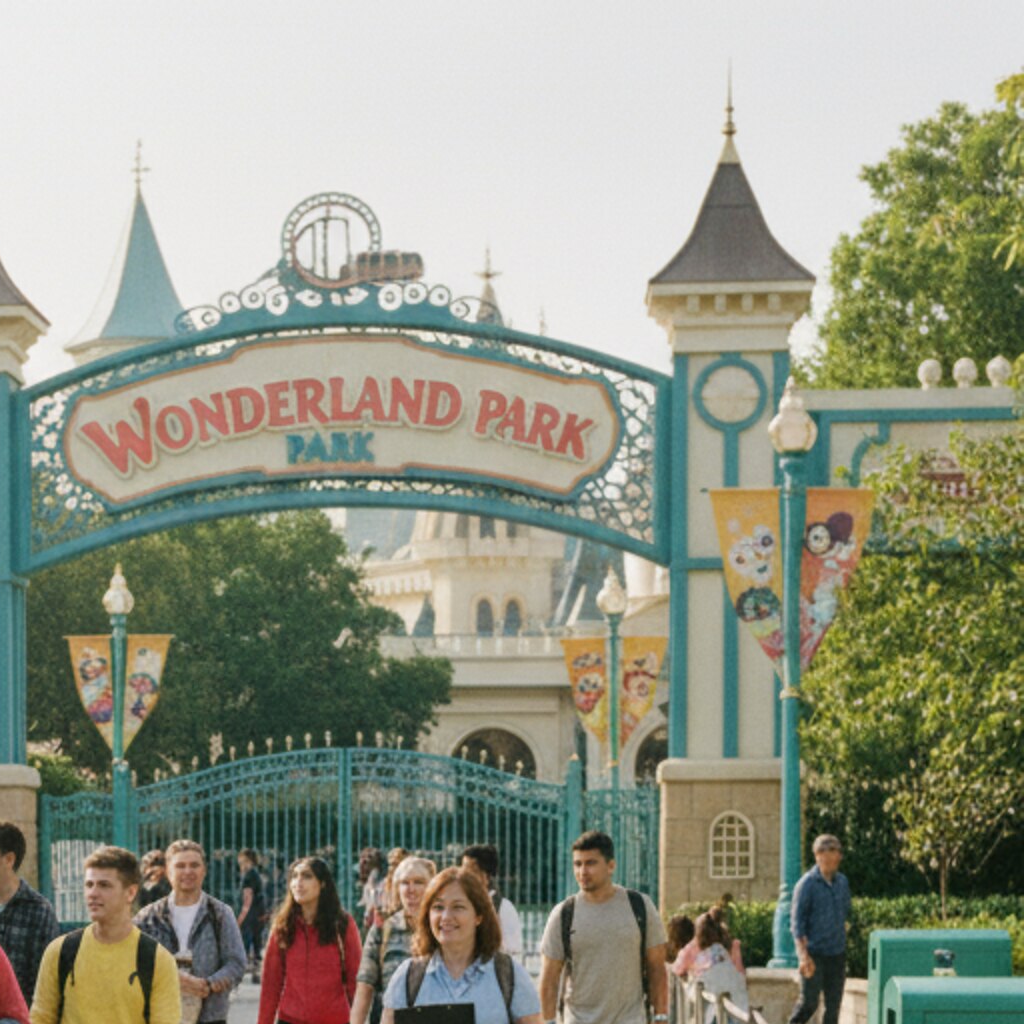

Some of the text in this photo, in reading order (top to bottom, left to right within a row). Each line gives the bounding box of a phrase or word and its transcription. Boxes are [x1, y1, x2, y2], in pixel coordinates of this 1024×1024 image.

[79, 375, 594, 474] WONDERLAND PARK
[285, 432, 376, 465] PARK
